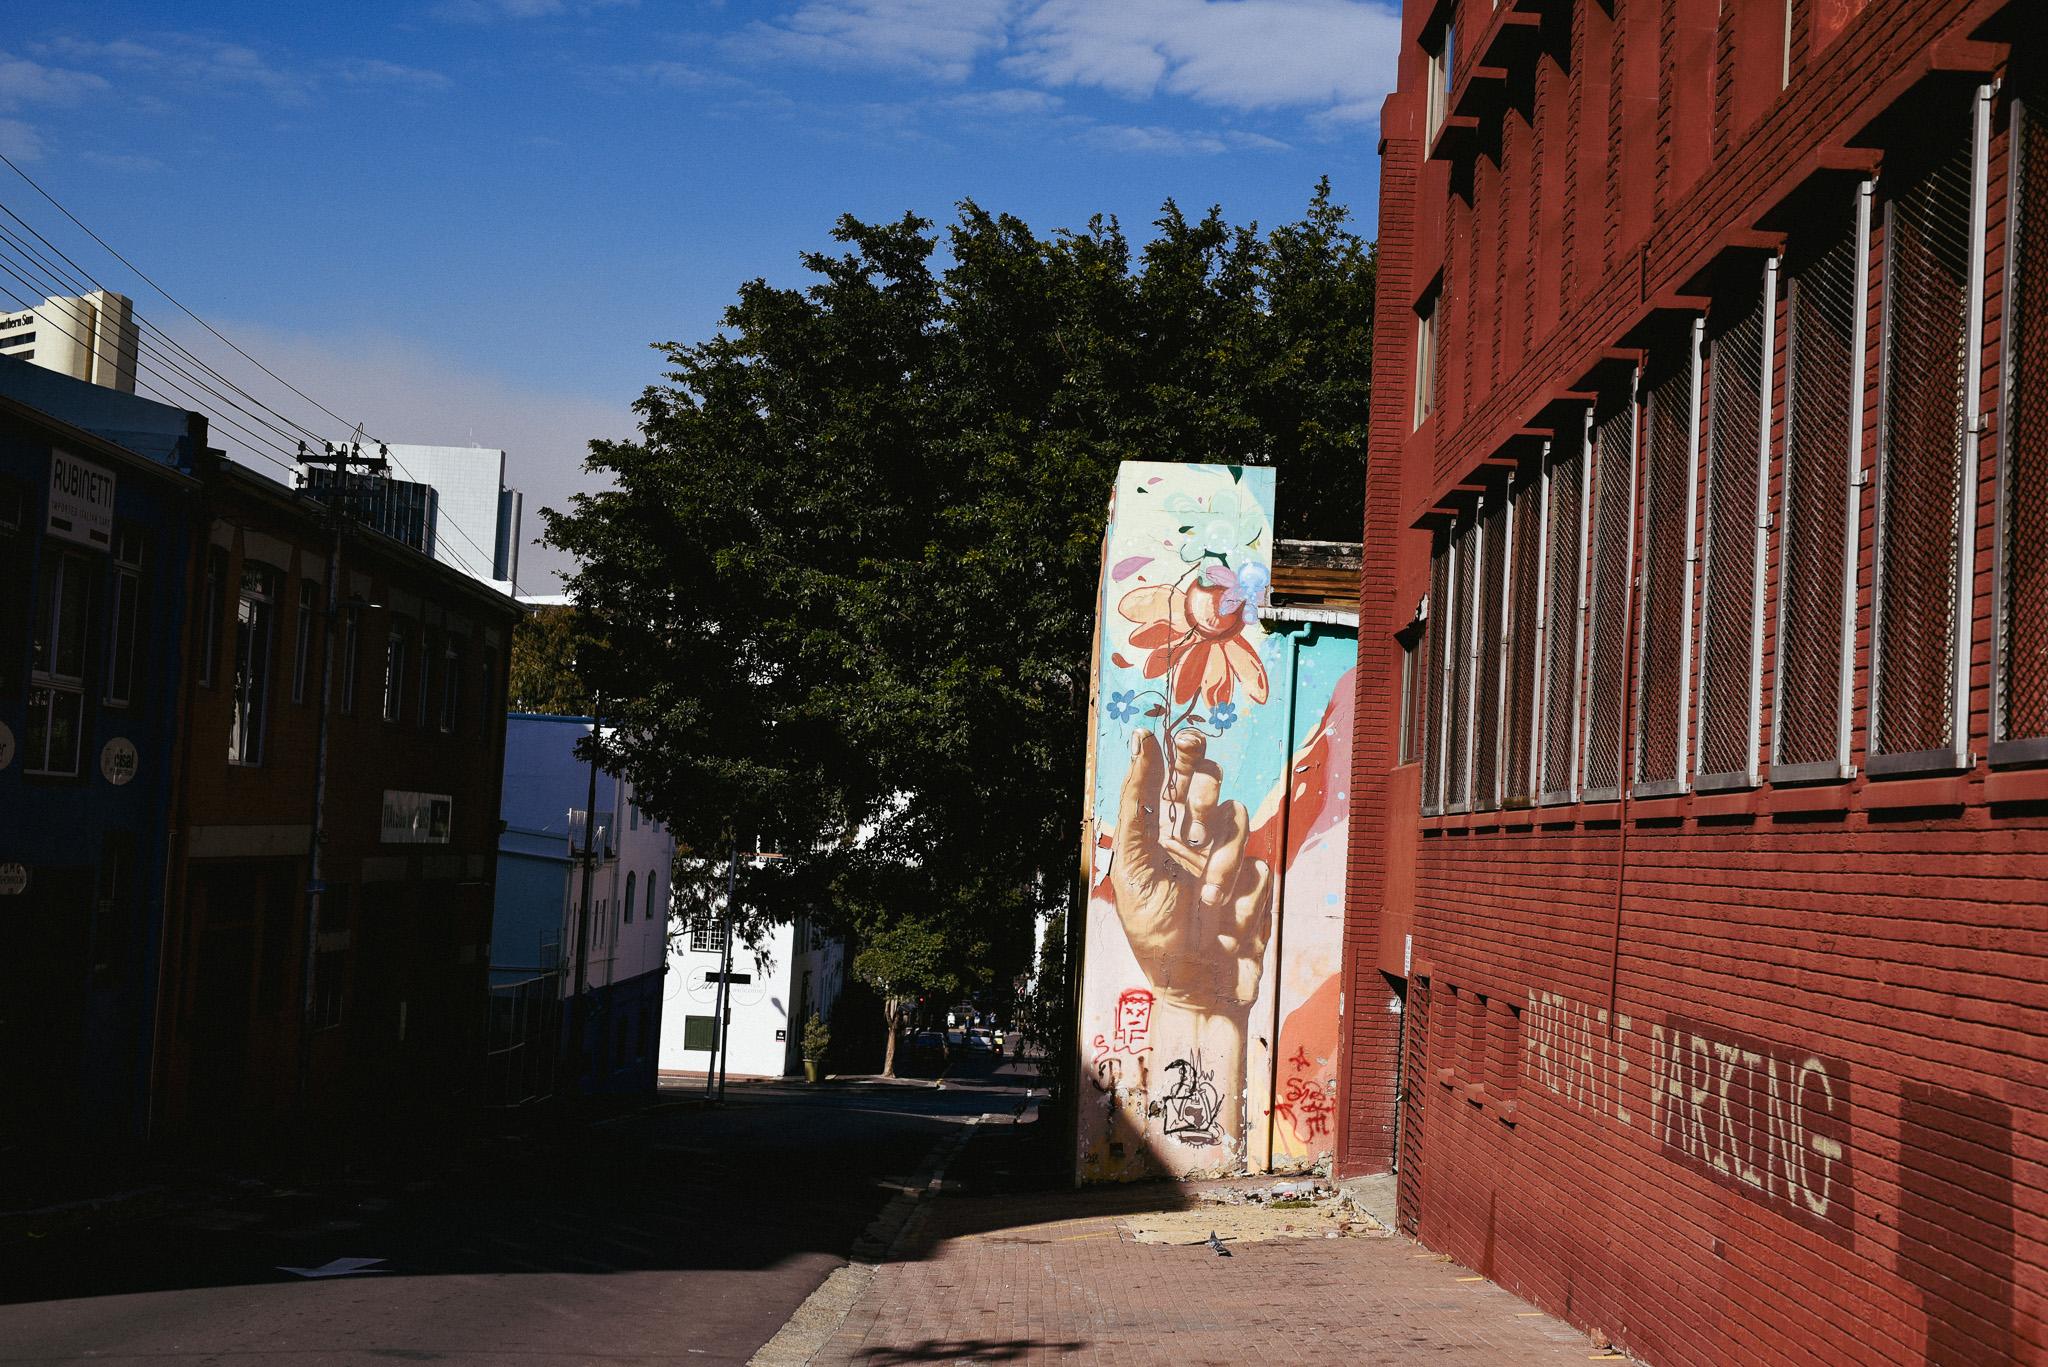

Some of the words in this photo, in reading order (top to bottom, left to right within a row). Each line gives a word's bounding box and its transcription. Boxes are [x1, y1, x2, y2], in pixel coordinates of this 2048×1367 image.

[0, 317, 21, 330] outhern
[22, 314, 33, 326] Sun
[53, 459, 113, 509] RUBINETTI
[1527, 989, 1632, 1125] PRIVATE
[1652, 1024, 1841, 1220] PARKING
